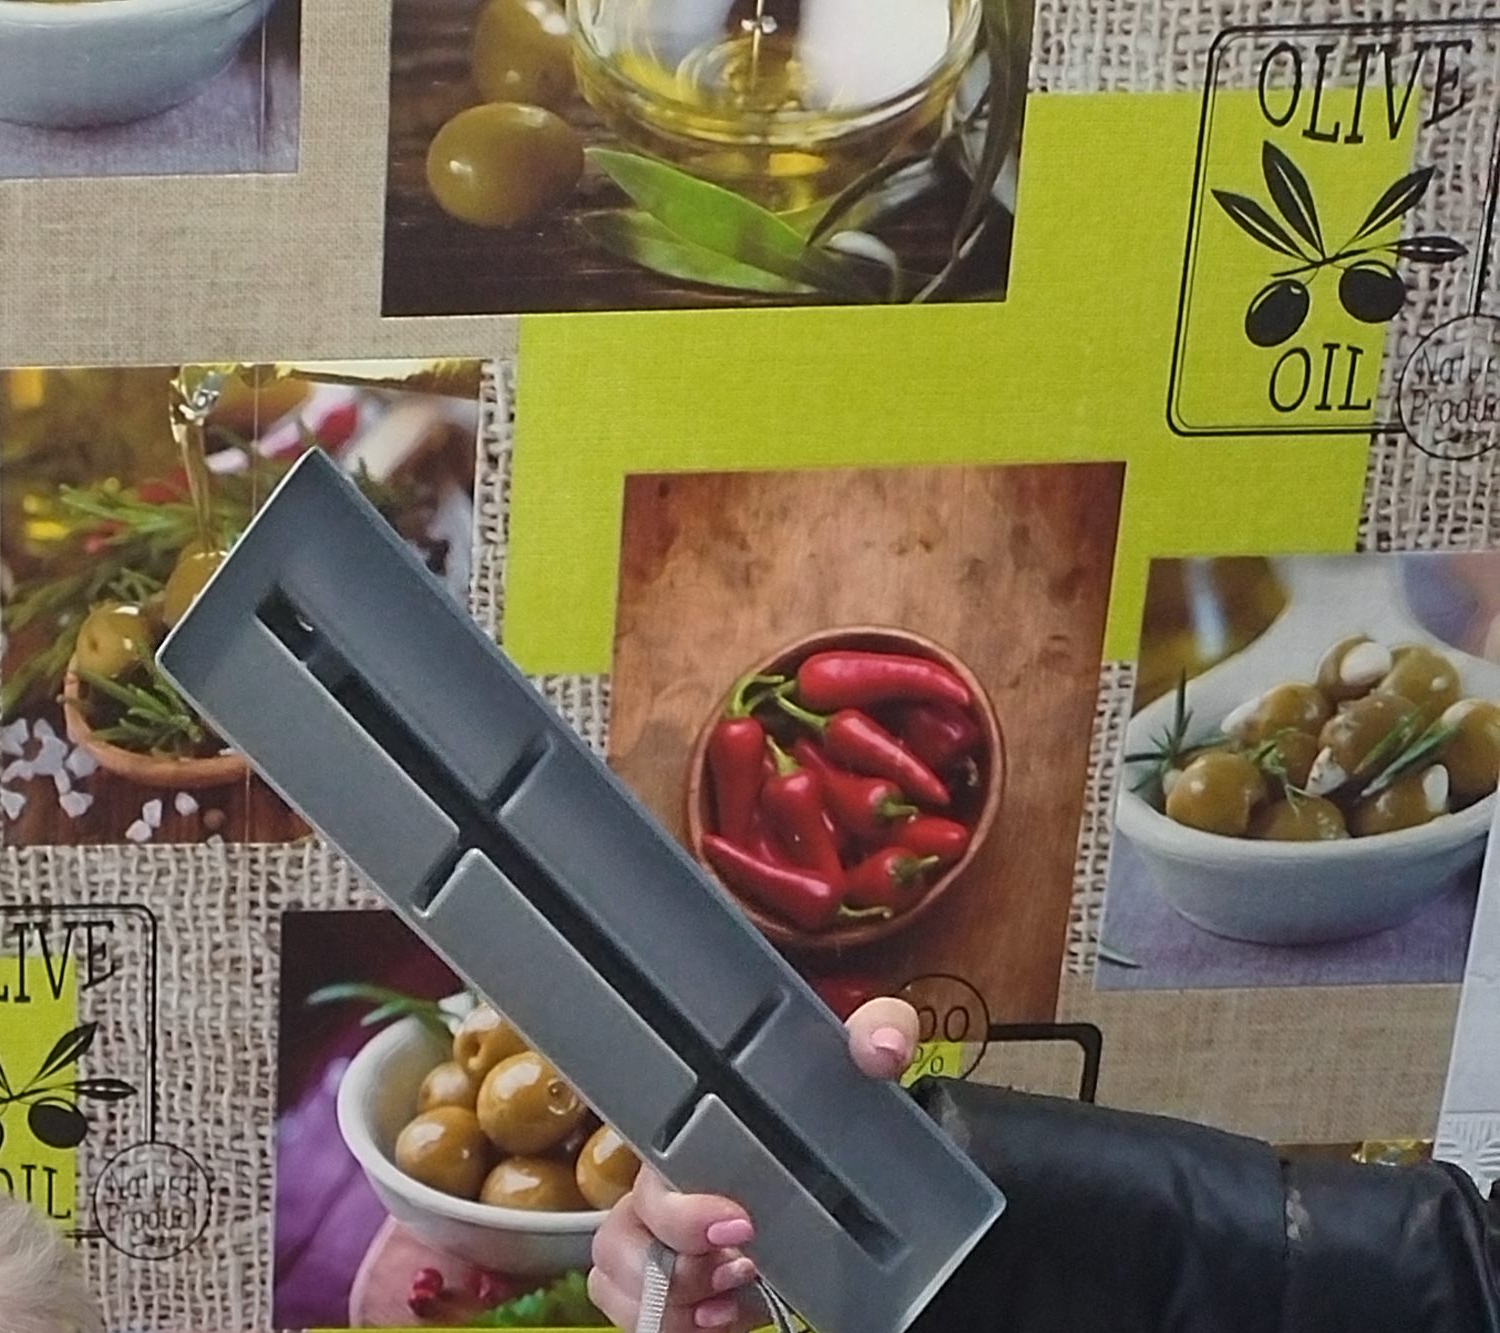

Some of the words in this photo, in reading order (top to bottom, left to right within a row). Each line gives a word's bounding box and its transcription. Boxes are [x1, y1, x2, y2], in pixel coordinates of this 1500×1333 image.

[1258, 39, 1471, 144] OLIVE
[1269, 343, 1371, 412] OIL
[918, 1005, 970, 1044] 00
